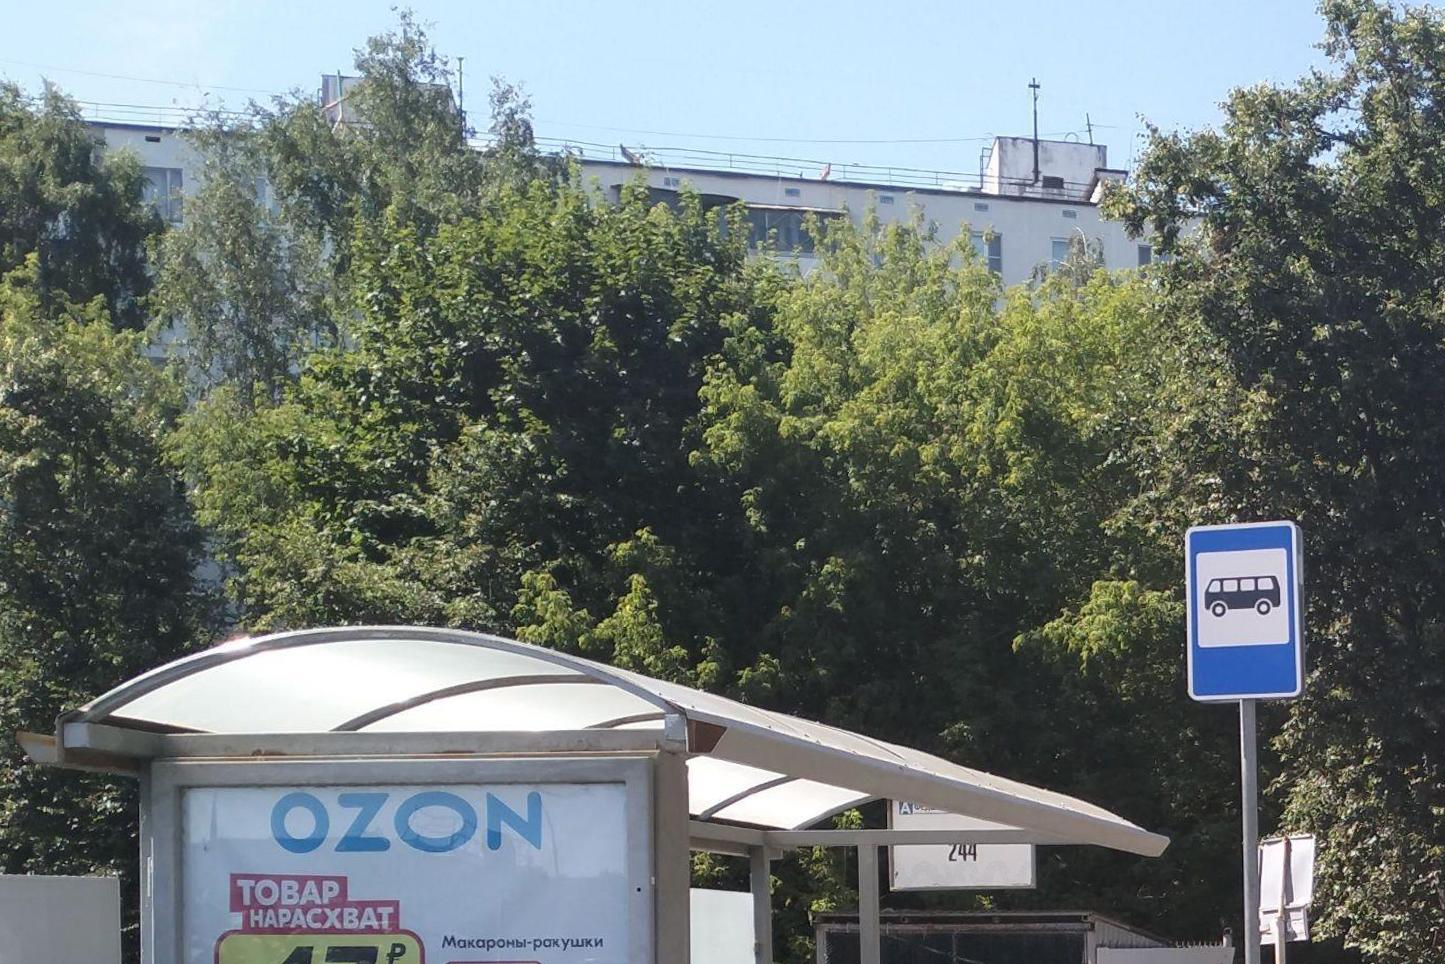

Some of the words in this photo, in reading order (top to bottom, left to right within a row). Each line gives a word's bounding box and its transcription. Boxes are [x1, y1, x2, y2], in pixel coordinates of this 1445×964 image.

[270, 791, 543, 854] OZON
[948, 844, 978, 862] 244
[237, 879, 340, 906] ТОВАР
[249, 906, 394, 931] НАРАСХВАТ
[441, 934, 604, 952] Макароны-ракушки
